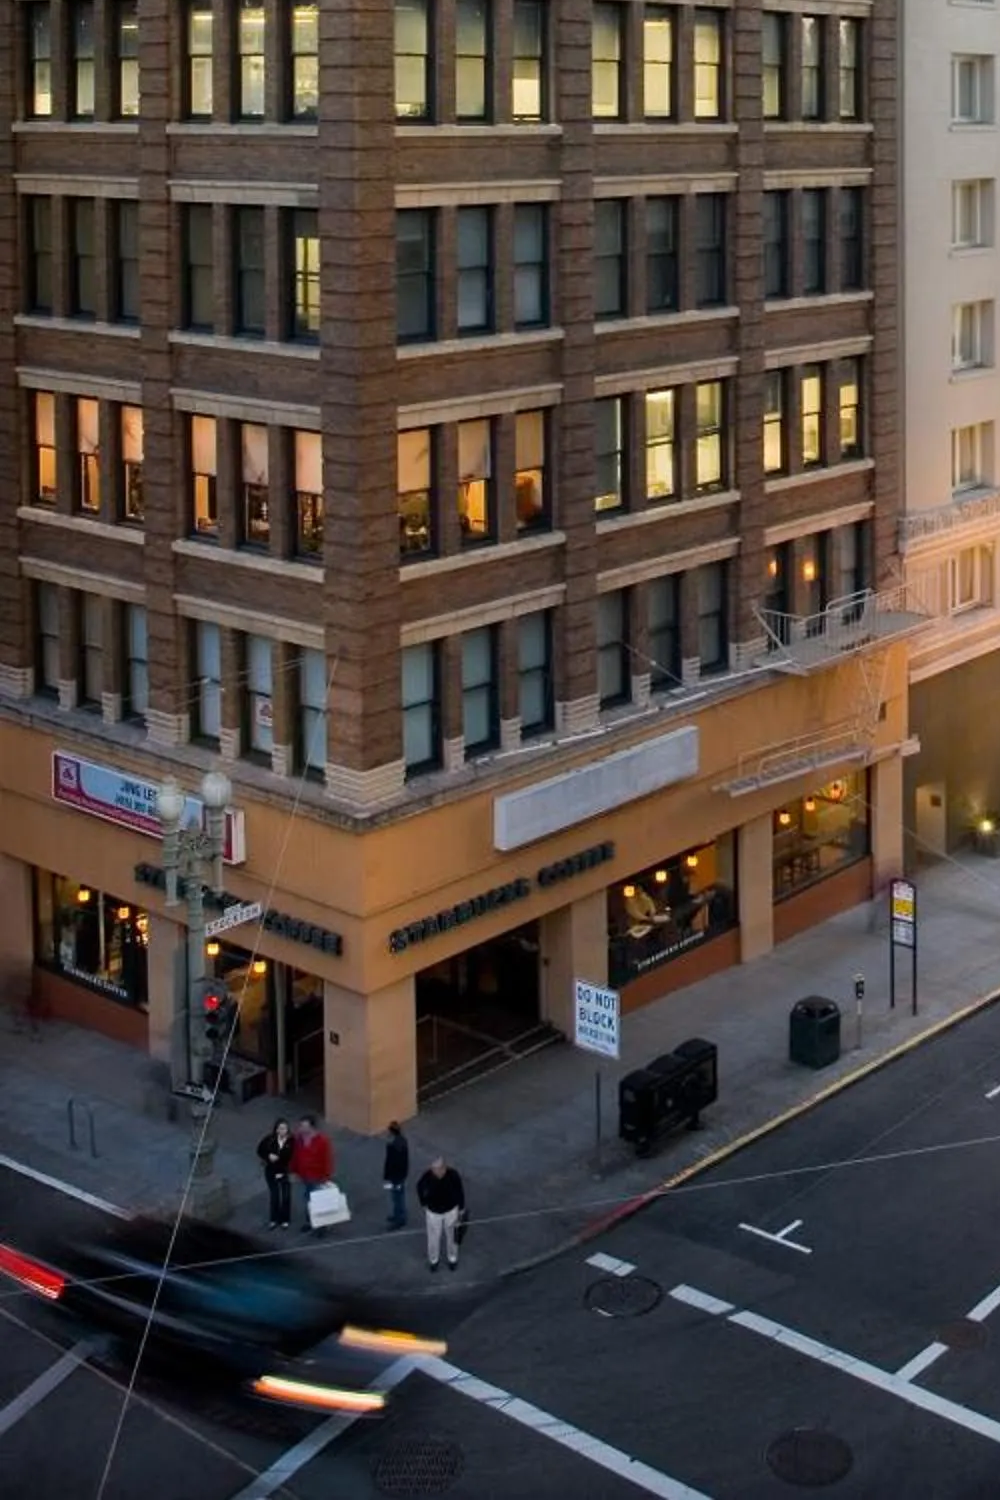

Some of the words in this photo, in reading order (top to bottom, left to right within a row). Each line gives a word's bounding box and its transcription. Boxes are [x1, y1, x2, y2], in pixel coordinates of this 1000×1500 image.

[577, 985, 591, 1003] DO
[595, 992, 615, 1011] NOT
[579, 1007, 615, 1032] BLOCK
